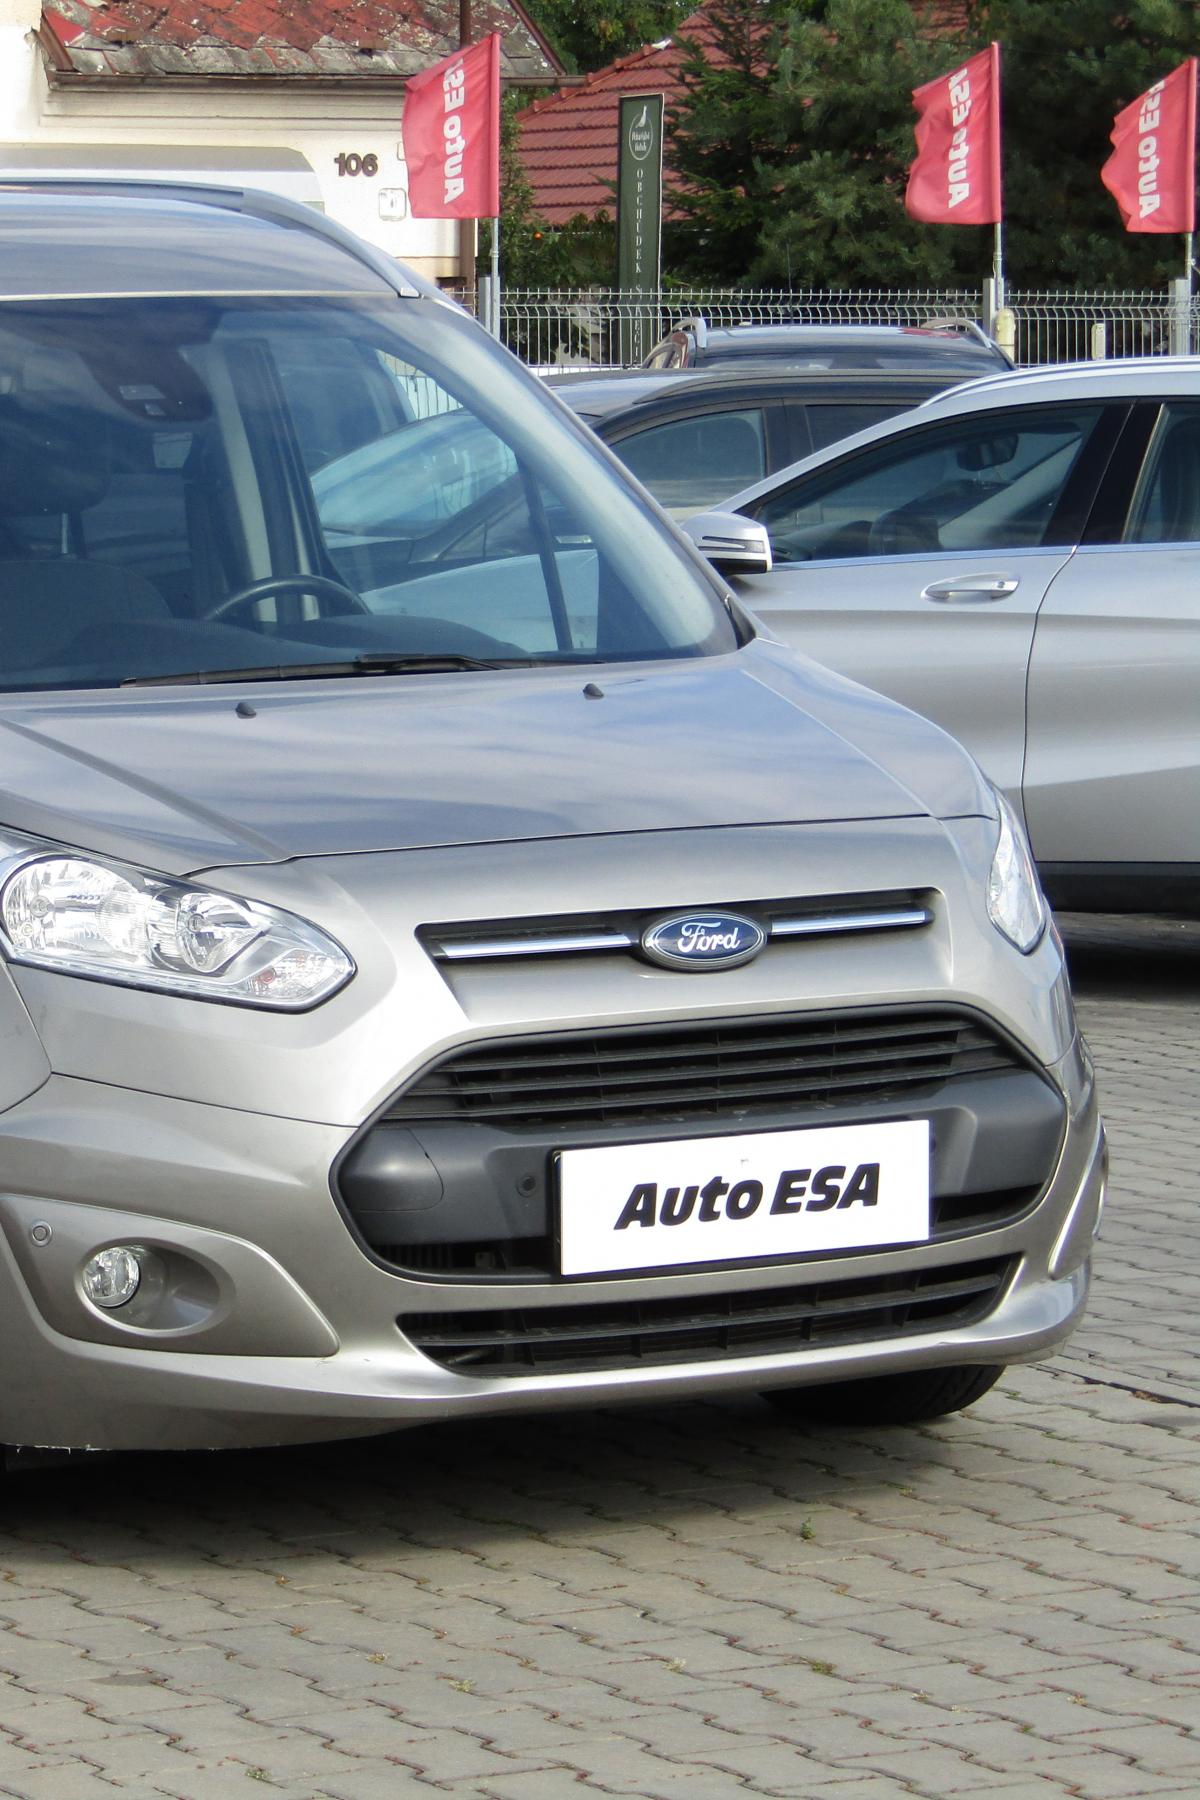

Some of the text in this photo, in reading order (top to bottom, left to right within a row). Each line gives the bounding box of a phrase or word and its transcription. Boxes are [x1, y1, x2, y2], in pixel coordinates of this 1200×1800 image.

[334, 152, 378, 177] 106
[677, 922, 740, 953] Ford
[613, 1163, 880, 1230] Auto ESA
